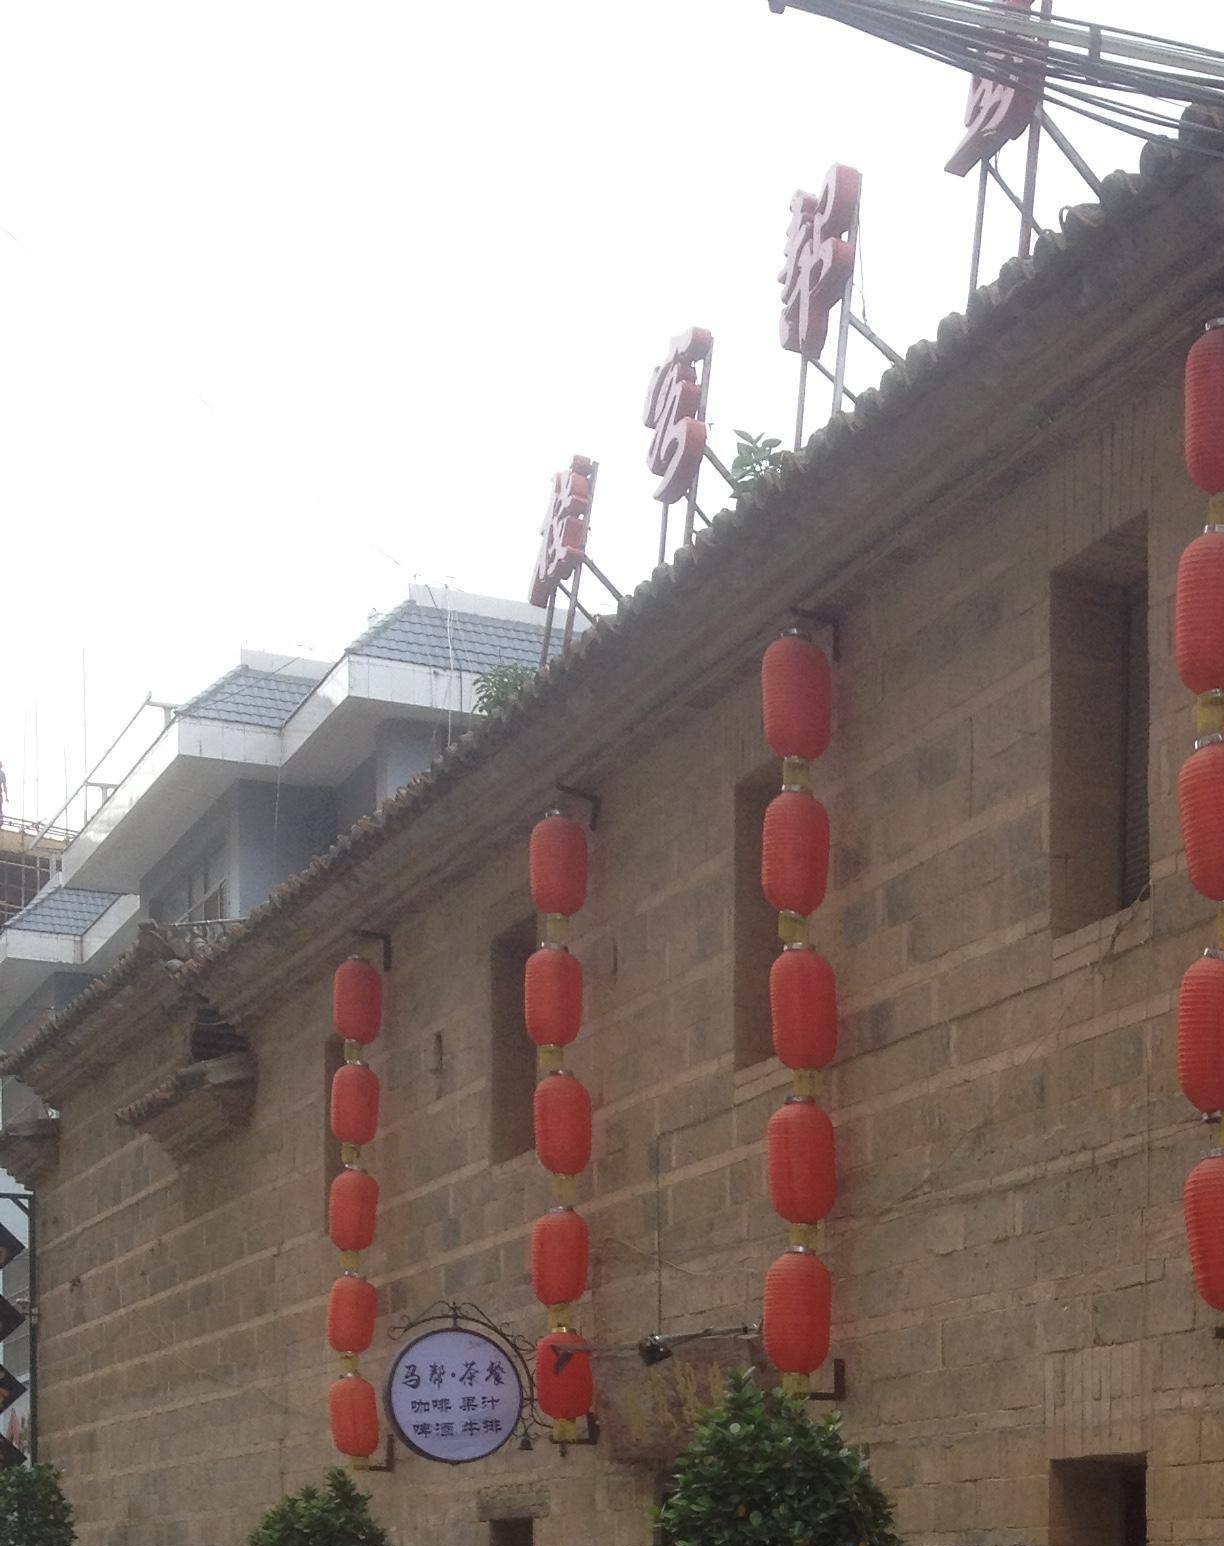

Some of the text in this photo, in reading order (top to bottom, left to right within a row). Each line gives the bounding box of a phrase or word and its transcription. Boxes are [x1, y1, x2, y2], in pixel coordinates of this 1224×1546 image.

[411, 1396, 501, 1414] 咖啡 果汁
[413, 1418, 502, 1438] 啤酒 牛排
